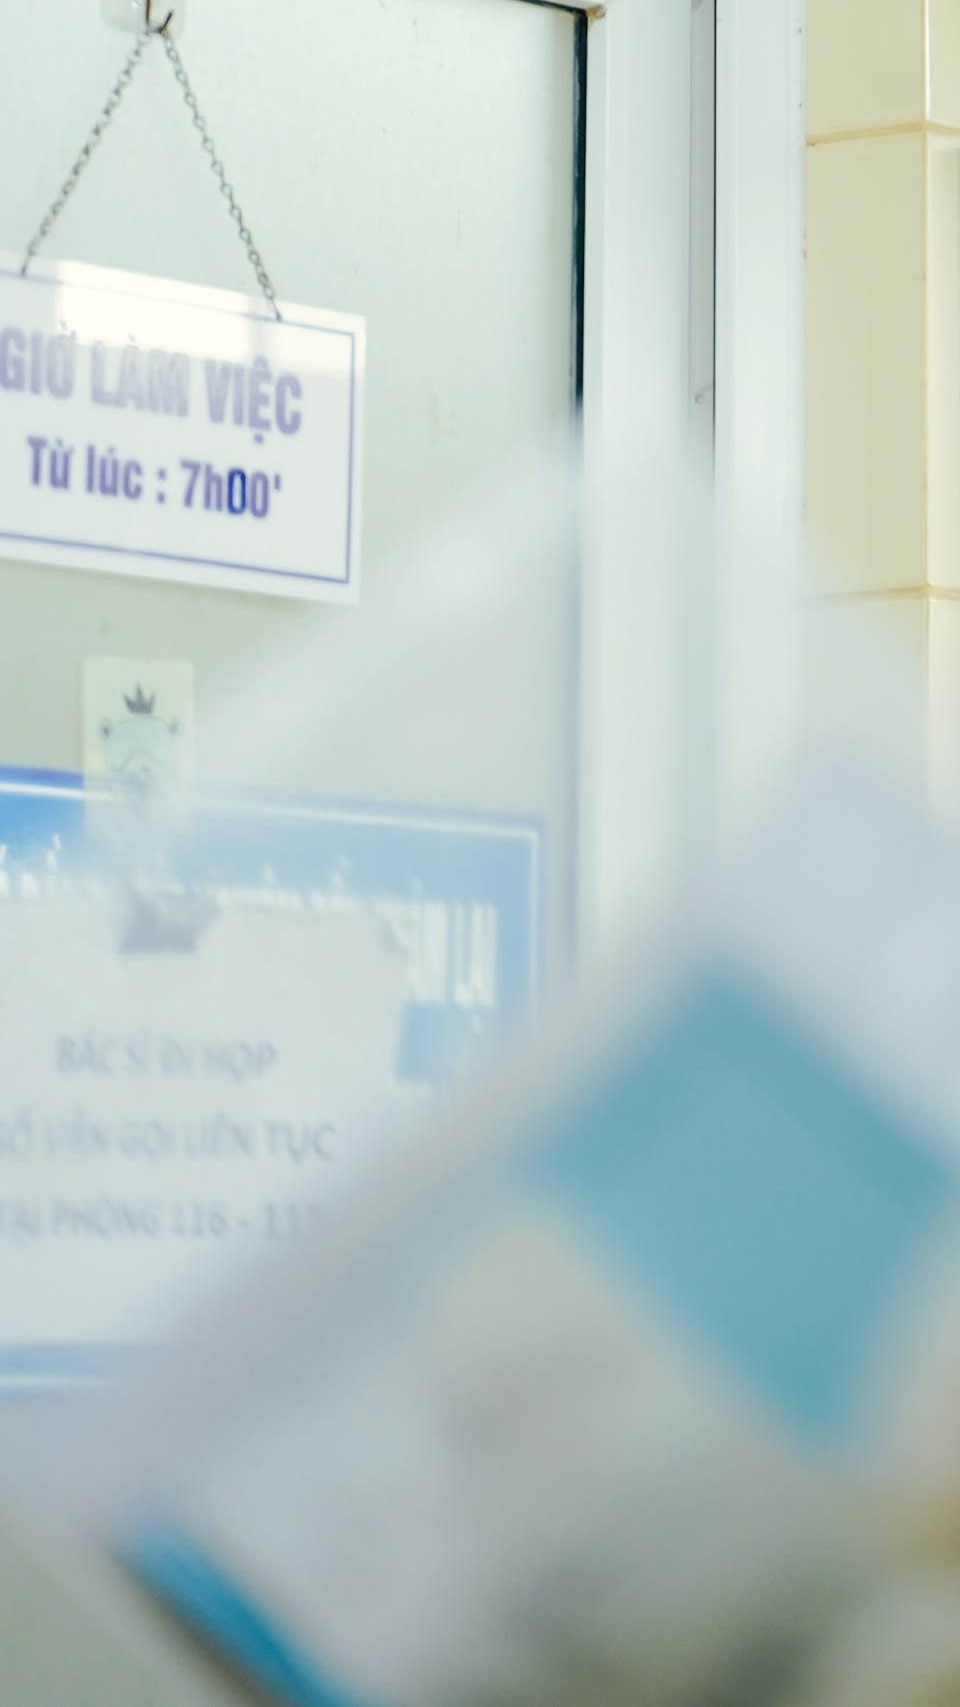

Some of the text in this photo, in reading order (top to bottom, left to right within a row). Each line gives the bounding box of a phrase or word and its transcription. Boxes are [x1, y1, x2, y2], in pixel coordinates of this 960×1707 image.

[90, 335, 190, 418] LÀM
[206, 354, 303, 444] VIỆC
[27, 436, 75, 490] Từ
[86, 443, 143, 500] lúc
